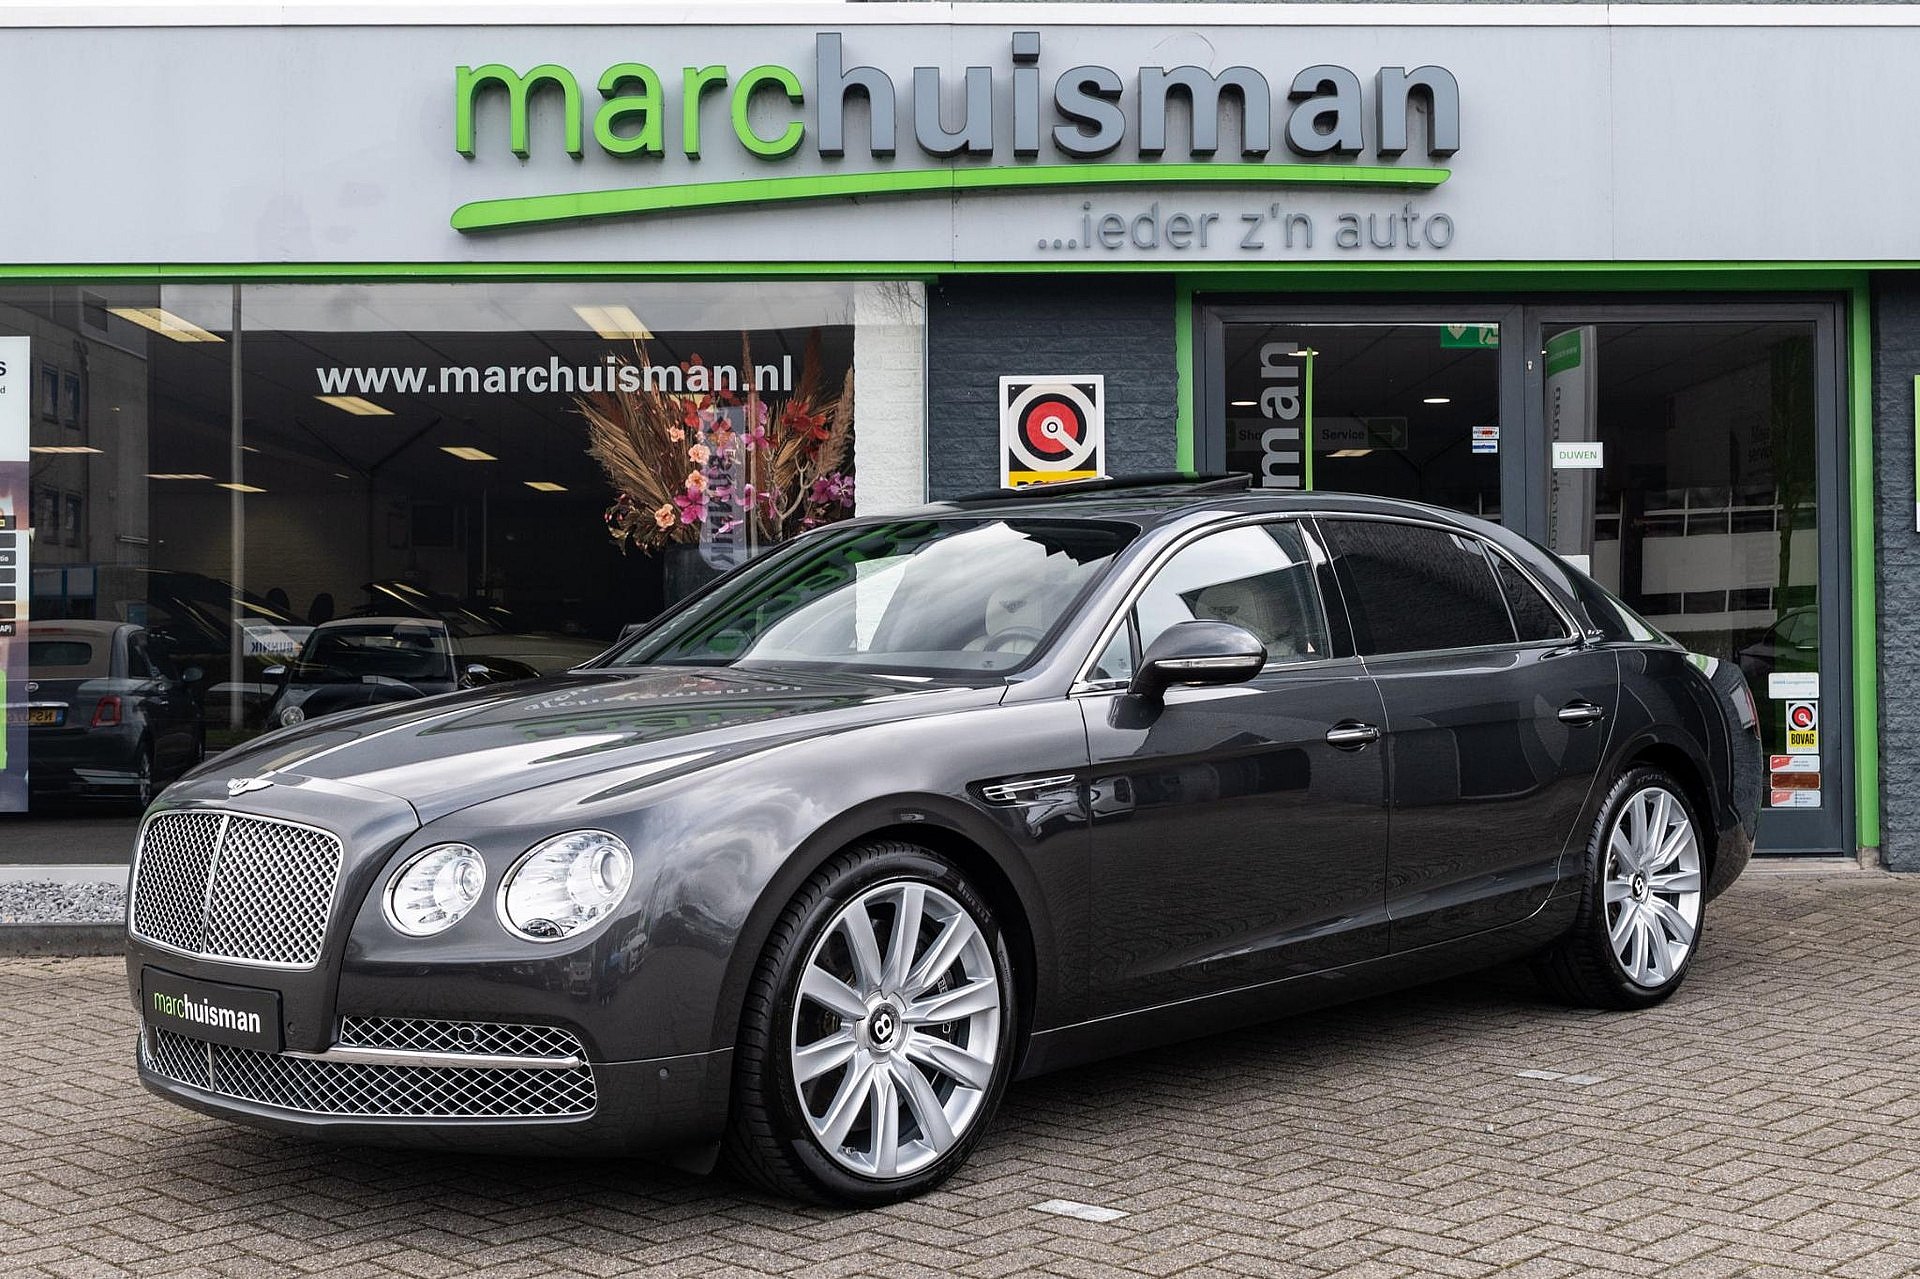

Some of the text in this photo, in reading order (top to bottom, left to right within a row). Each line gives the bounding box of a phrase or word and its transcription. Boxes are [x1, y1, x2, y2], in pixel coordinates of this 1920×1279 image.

[456, 32, 1460, 161] marchuisman
[1240, 202, 1312, 248] z'n
[1335, 201, 1454, 248] auto
[316, 356, 792, 393] www.marchuisman.nl
[1322, 429, 1365, 440] Service
[1559, 450, 1597, 460] DUWEN
[1791, 733, 1815, 745] BOVAG
[153, 992, 261, 1034] marchuisman
